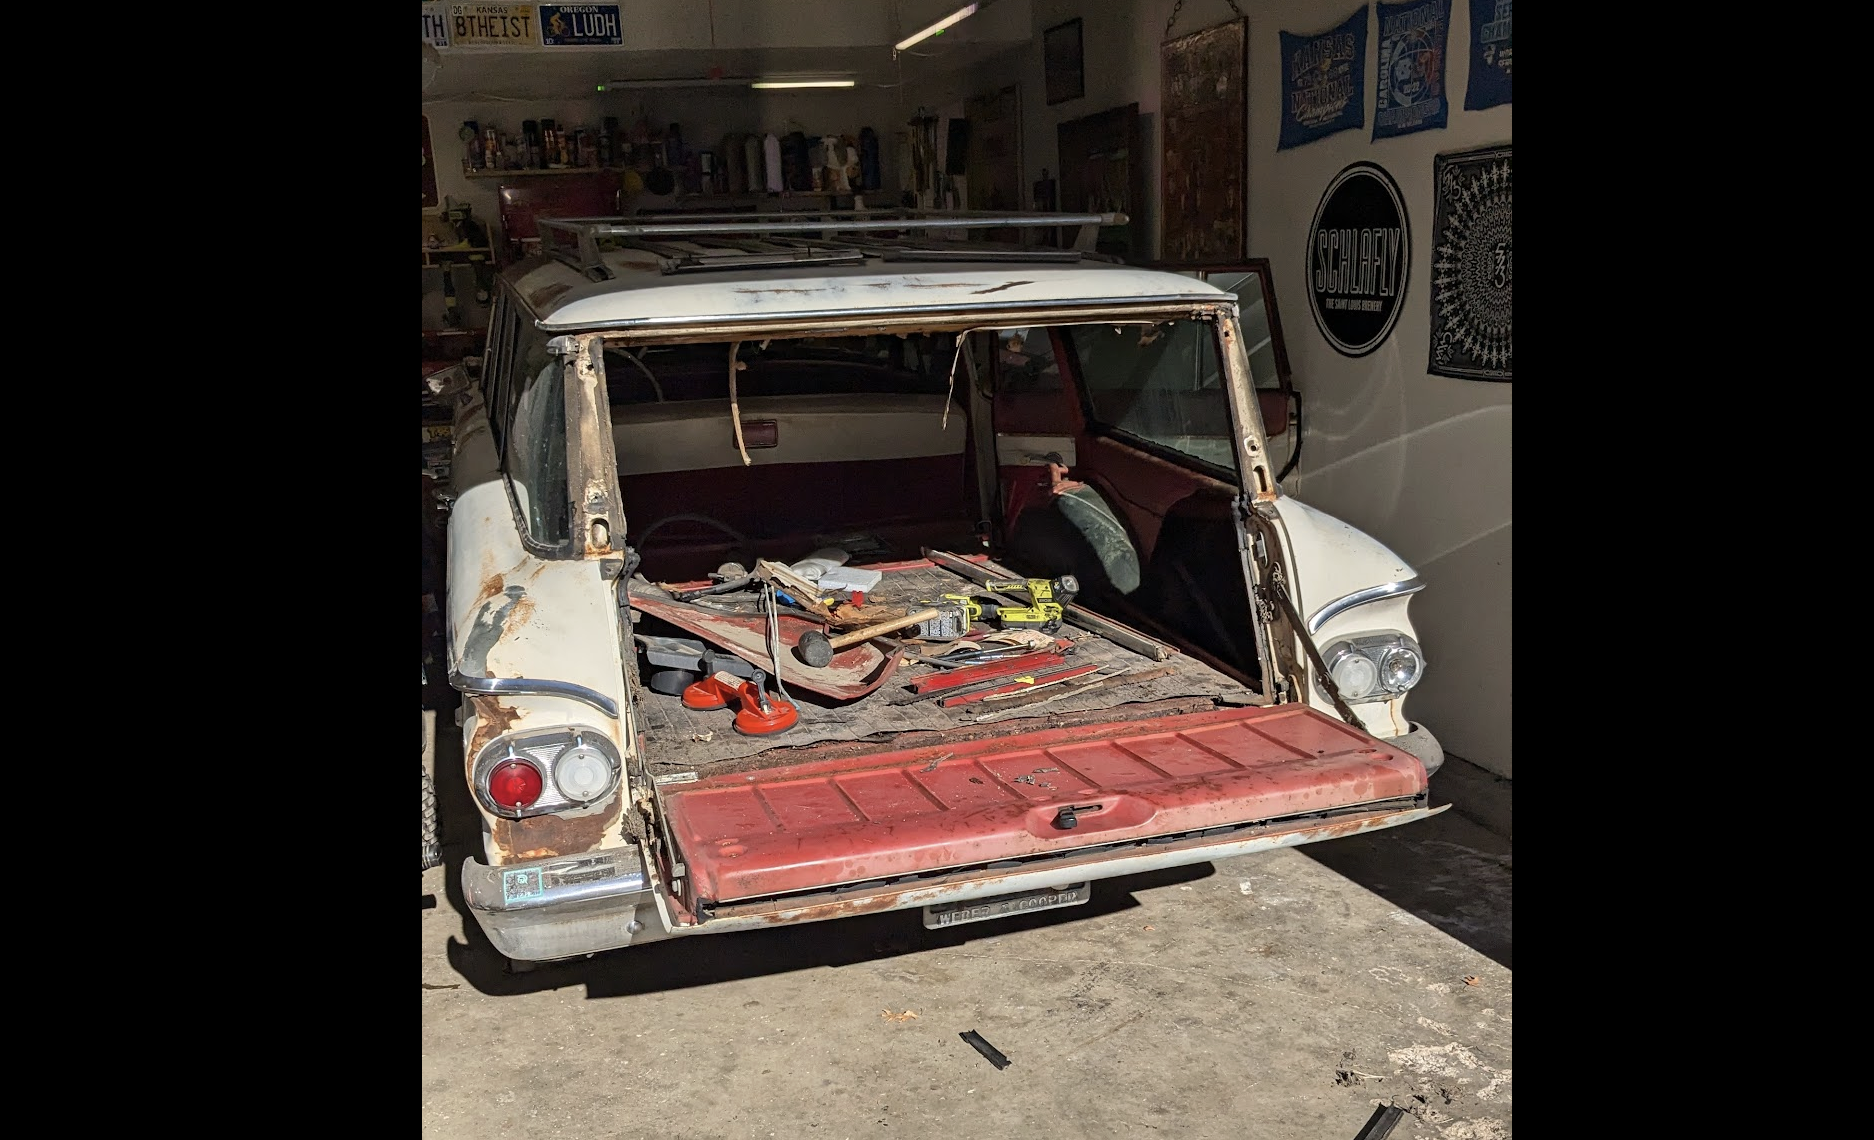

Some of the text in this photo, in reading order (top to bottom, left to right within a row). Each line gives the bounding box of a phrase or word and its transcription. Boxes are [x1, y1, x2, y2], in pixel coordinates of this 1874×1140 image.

[476, 6, 508, 14] KANSAS
[571, 13, 618, 36] LUDH
[1383, 0, 1445, 37] NATIONAL
[1291, 75, 1355, 114] NATIONAL
[1316, 228, 1400, 297] SCHLAFLY
[1326, 298, 1383, 312] THE SAINT LOUIS BREWERY
[939, 905, 991, 925] WEBER
[1018, 891, 1078, 911] COOPER
